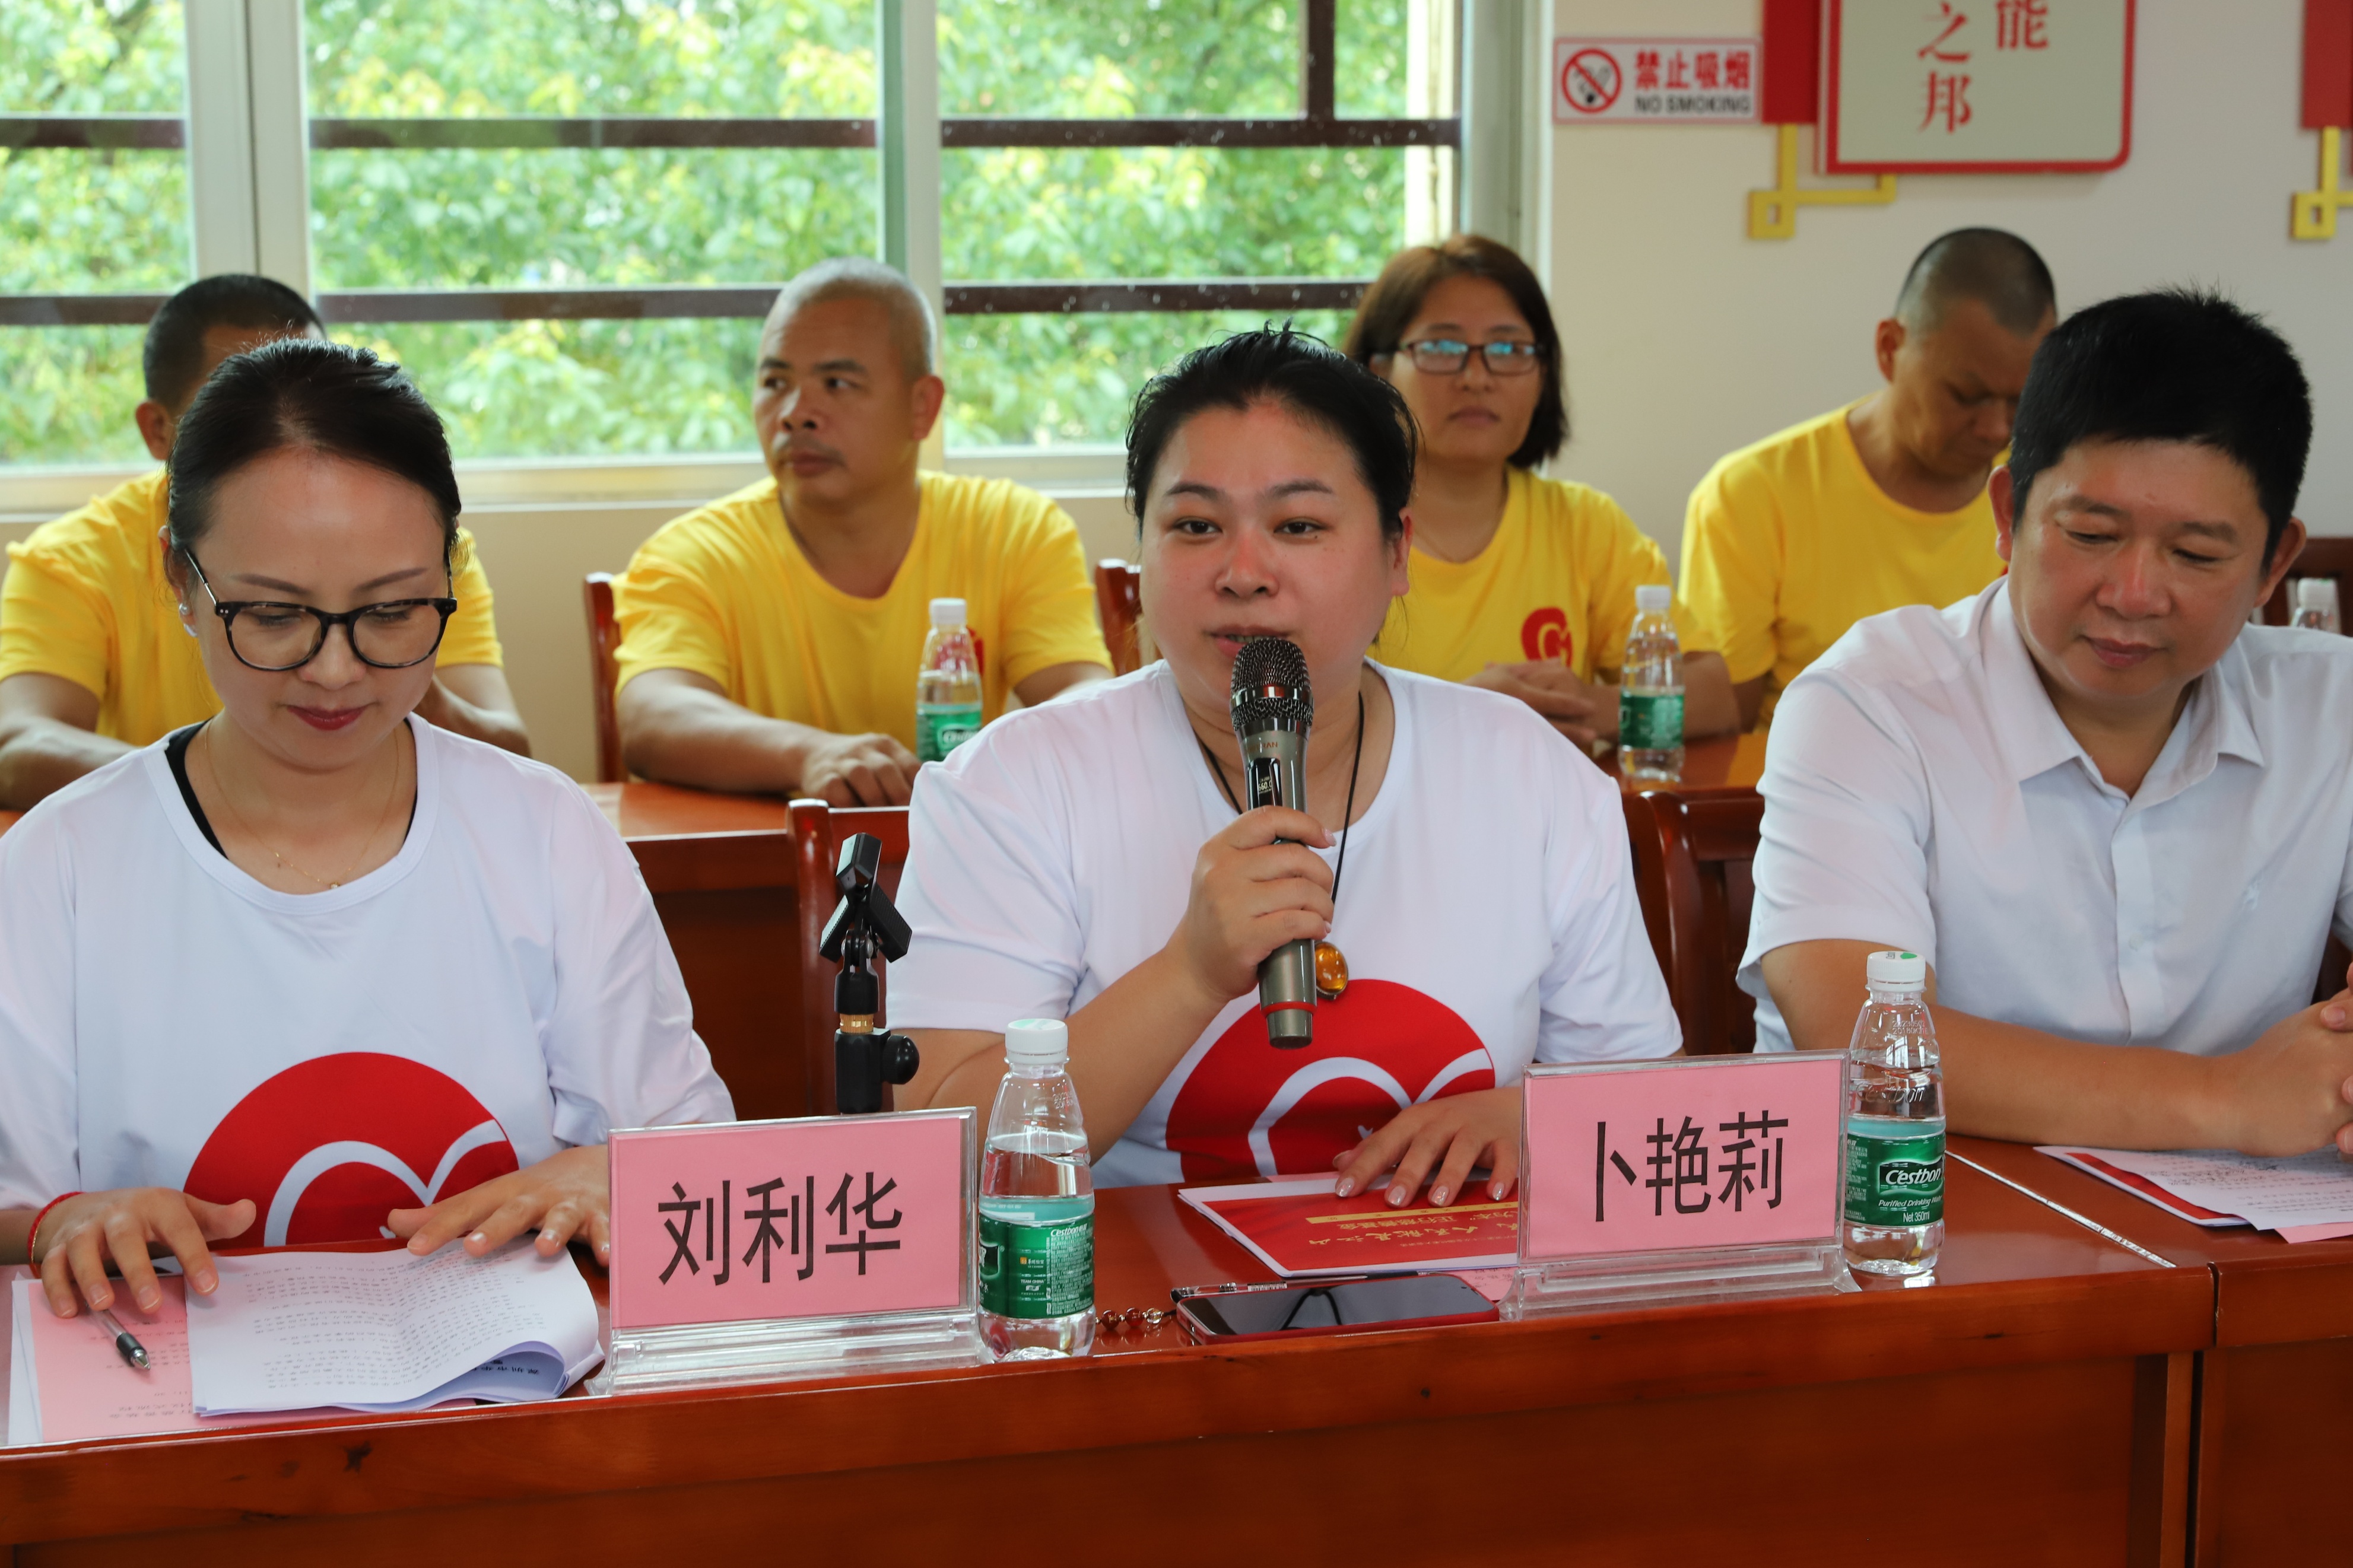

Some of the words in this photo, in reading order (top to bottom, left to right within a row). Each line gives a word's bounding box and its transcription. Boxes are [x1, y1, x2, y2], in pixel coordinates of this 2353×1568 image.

[1636, 49, 1750, 90] 禁止吸烟
[1917, 2, 1971, 133] 之邦
[1636, 94, 1661, 113] NO
[1666, 94, 1750, 113] SMOKING
[1596, 1110, 1789, 1222] 卜艳莉
[1903, 1212, 1914, 1222] Net
[1914, 1210, 1930, 1221] 350ml
[1907, 1198, 1931, 1207] Drinking
[658, 1172, 903, 1286] 刘利华
